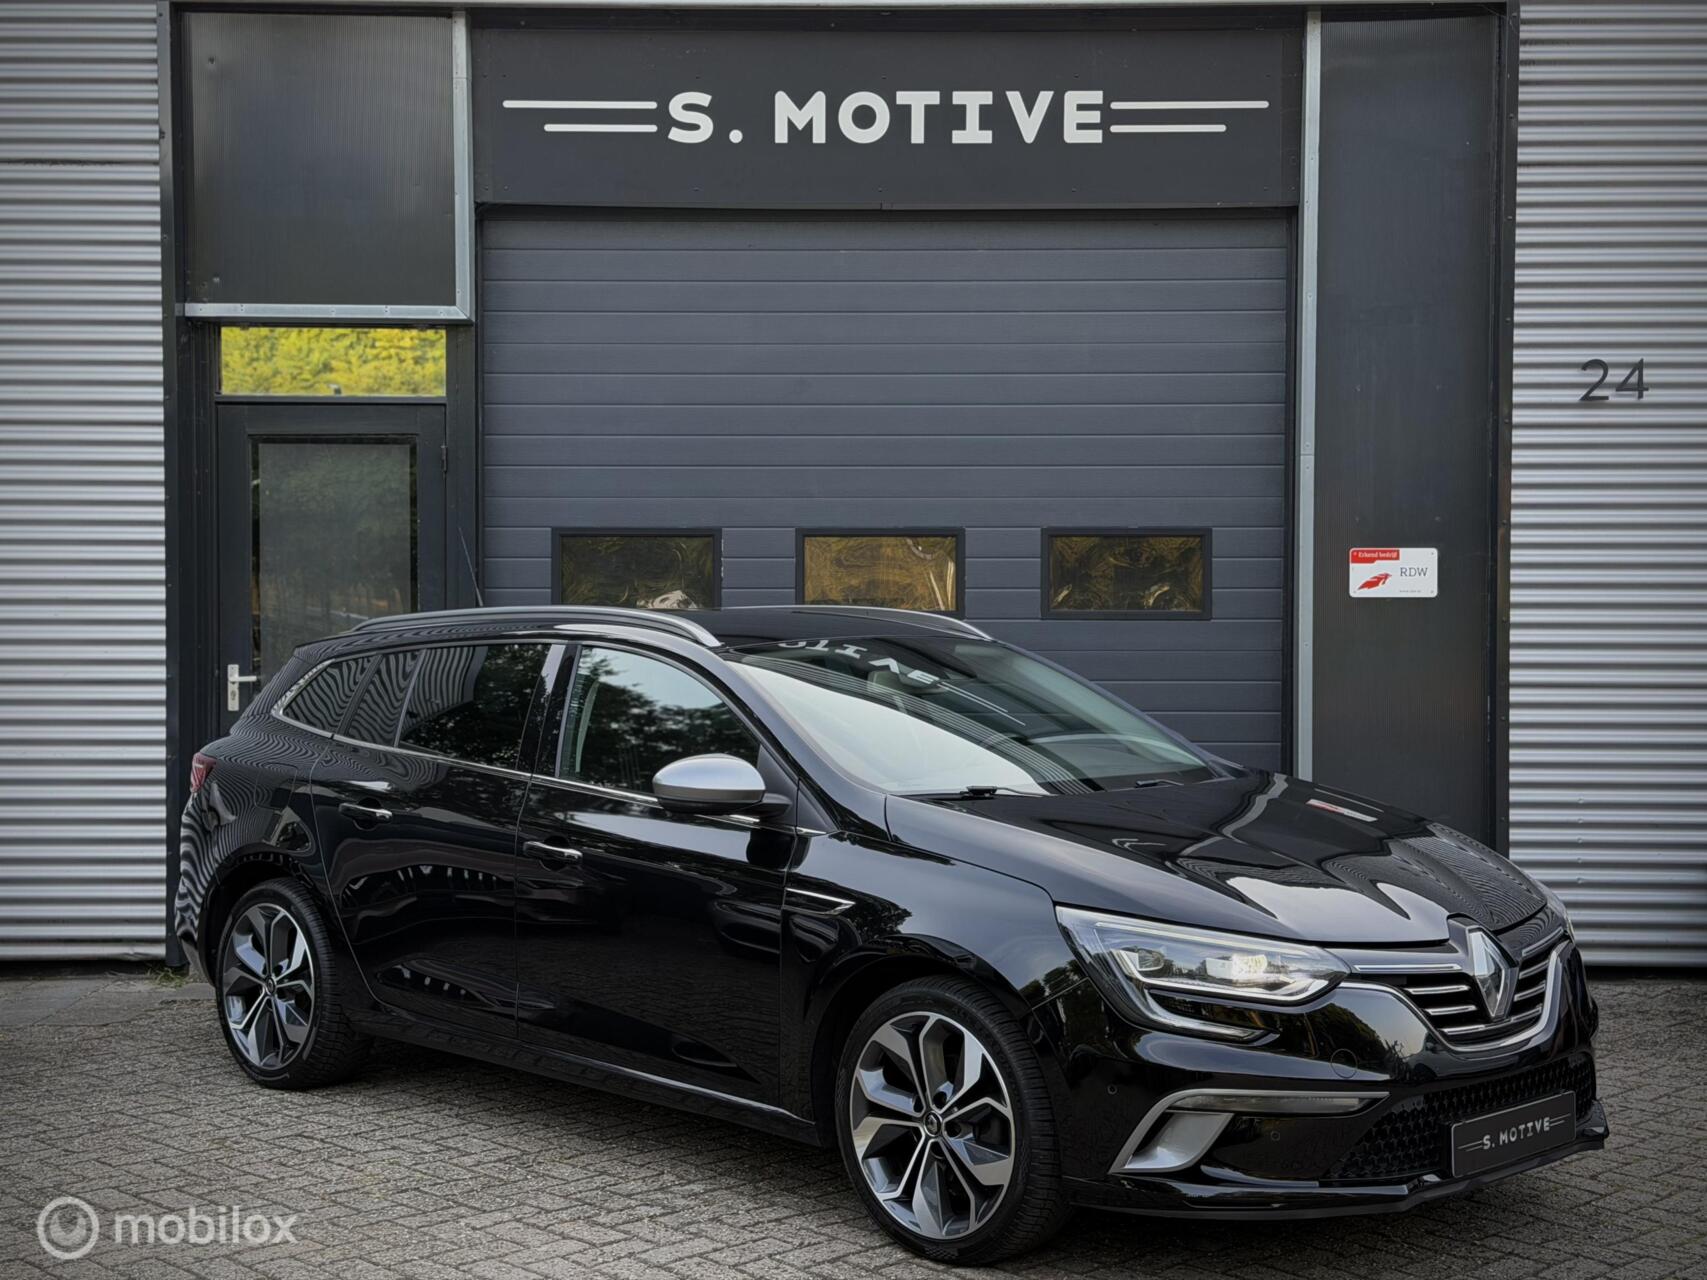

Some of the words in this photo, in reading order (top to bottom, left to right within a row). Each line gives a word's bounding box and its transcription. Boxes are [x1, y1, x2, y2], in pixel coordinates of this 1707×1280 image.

[667, 91, 743, 144] S.
[774, 90, 1104, 144] MOTIVE
[1579, 357, 1649, 401] 24
[1399, 567, 1428, 577] RDW
[1482, 1134, 1496, 1150] S.
[1499, 1117, 1550, 1146] MOTIVE
